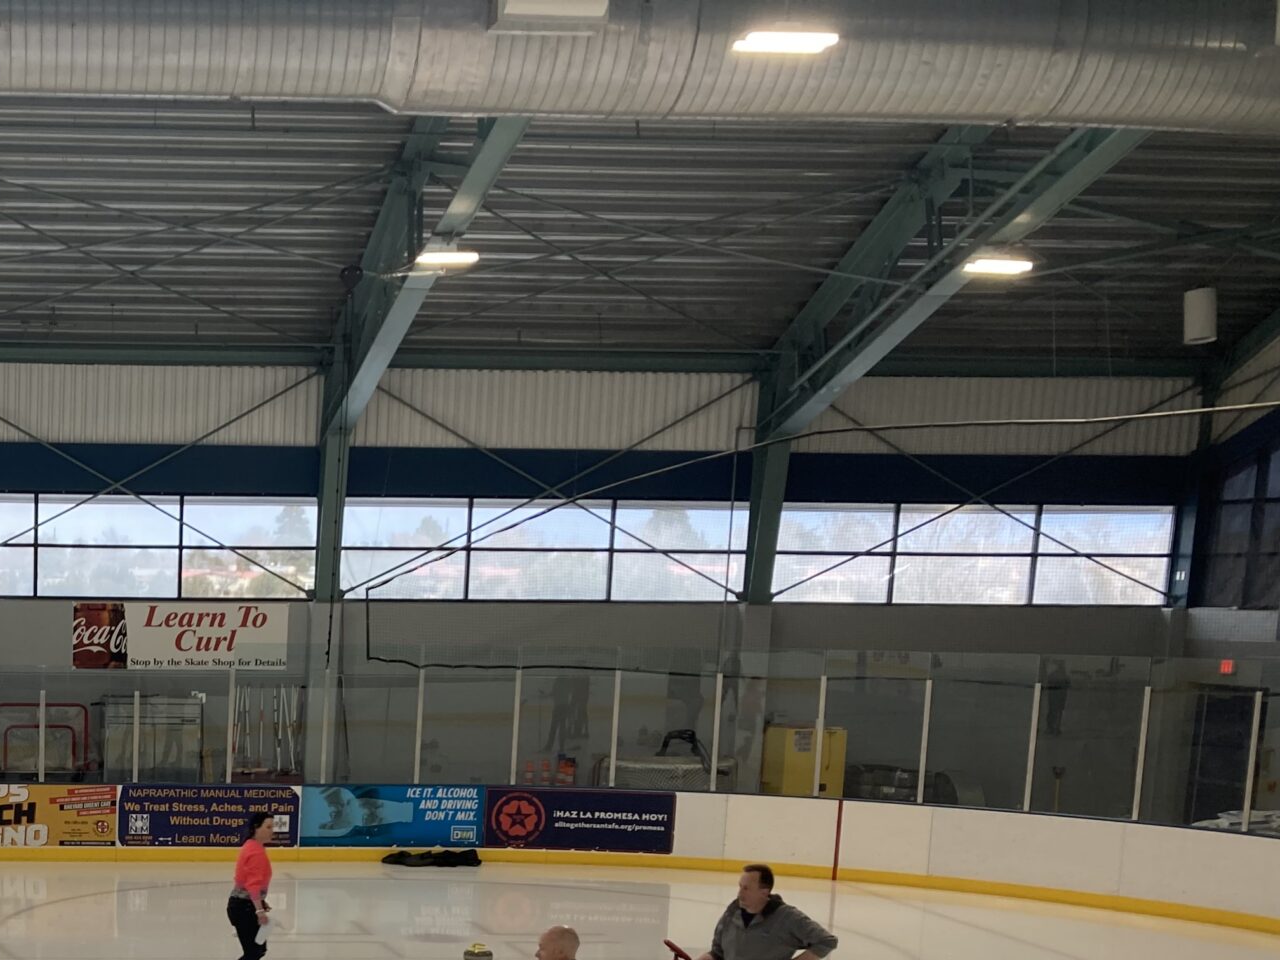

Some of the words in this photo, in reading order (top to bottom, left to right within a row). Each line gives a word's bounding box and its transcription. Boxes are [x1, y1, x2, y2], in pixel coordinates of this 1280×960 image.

[143, 605, 227, 628] Learn
[237, 605, 268, 629] To
[175, 629, 238, 652] Curl
[130, 658, 151, 667] Stop
[153, 658, 164, 668] by
[167, 658, 182, 666] the
[184, 658, 209, 666] Skate
[211, 658, 235, 668] Shop
[254, 658, 287, 667] Details
[128, 788, 198, 798] NAPRAPATHIC
[201, 788, 241, 798] MANUAL
[406, 787, 422, 798] ICE
[423, 787, 434, 798] IT.
[436, 787, 479, 798] ALCOHOL
[124, 802, 141, 811] We
[143, 802, 169, 812] Treat
[172, 802, 208, 813] Stress,
[210, 802, 246, 813] Aches,
[249, 803, 269, 812] and
[271, 803, 294, 812] Pain
[419, 799, 439, 809] AND
[440, 799, 479, 809] DRIVING
[169, 815, 210, 826] Without
[424, 809, 455, 821] DON'T
[455, 810, 477, 821] MIX.
[579, 811, 593, 819] LA
[594, 811, 640, 820] PROMESA
[641, 813, 668, 822] HOY!
[175, 833, 207, 843] Learn
